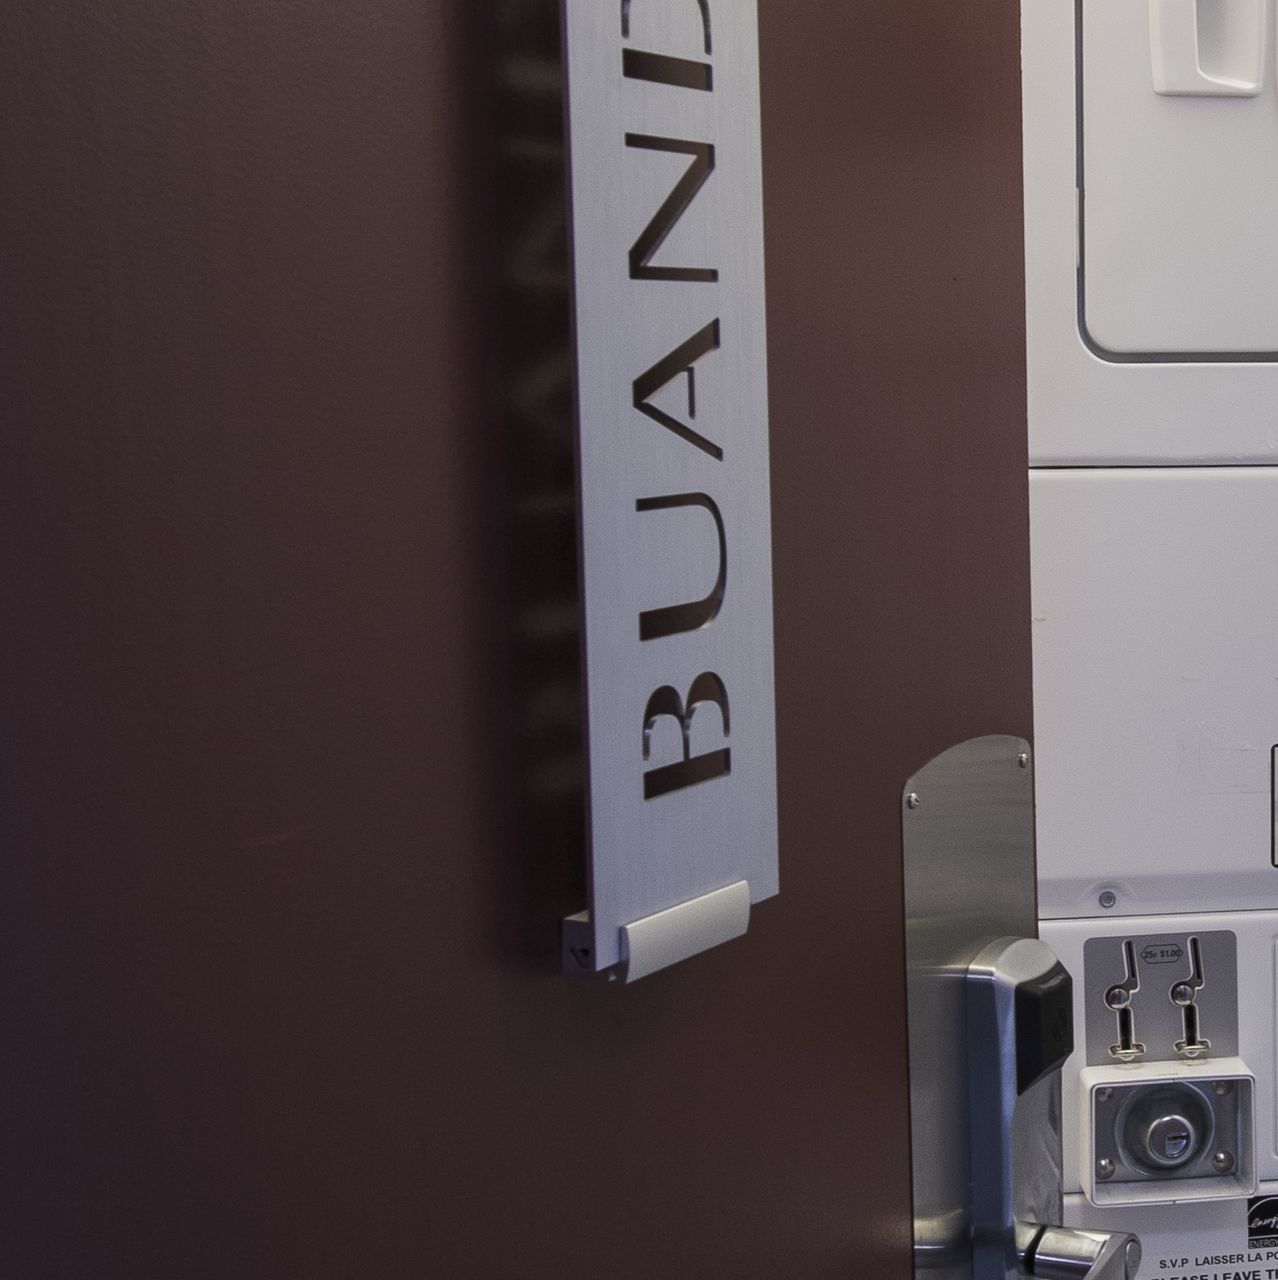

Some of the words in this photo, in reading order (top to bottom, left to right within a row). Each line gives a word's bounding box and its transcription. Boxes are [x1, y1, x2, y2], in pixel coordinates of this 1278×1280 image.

[1249, 1238, 1278, 1248] ENERGY
[1160, 1258, 1188, 1269] S.V.P
[1195, 1254, 1244, 1266] LAISSER
[1248, 1252, 1262, 1262] LA
